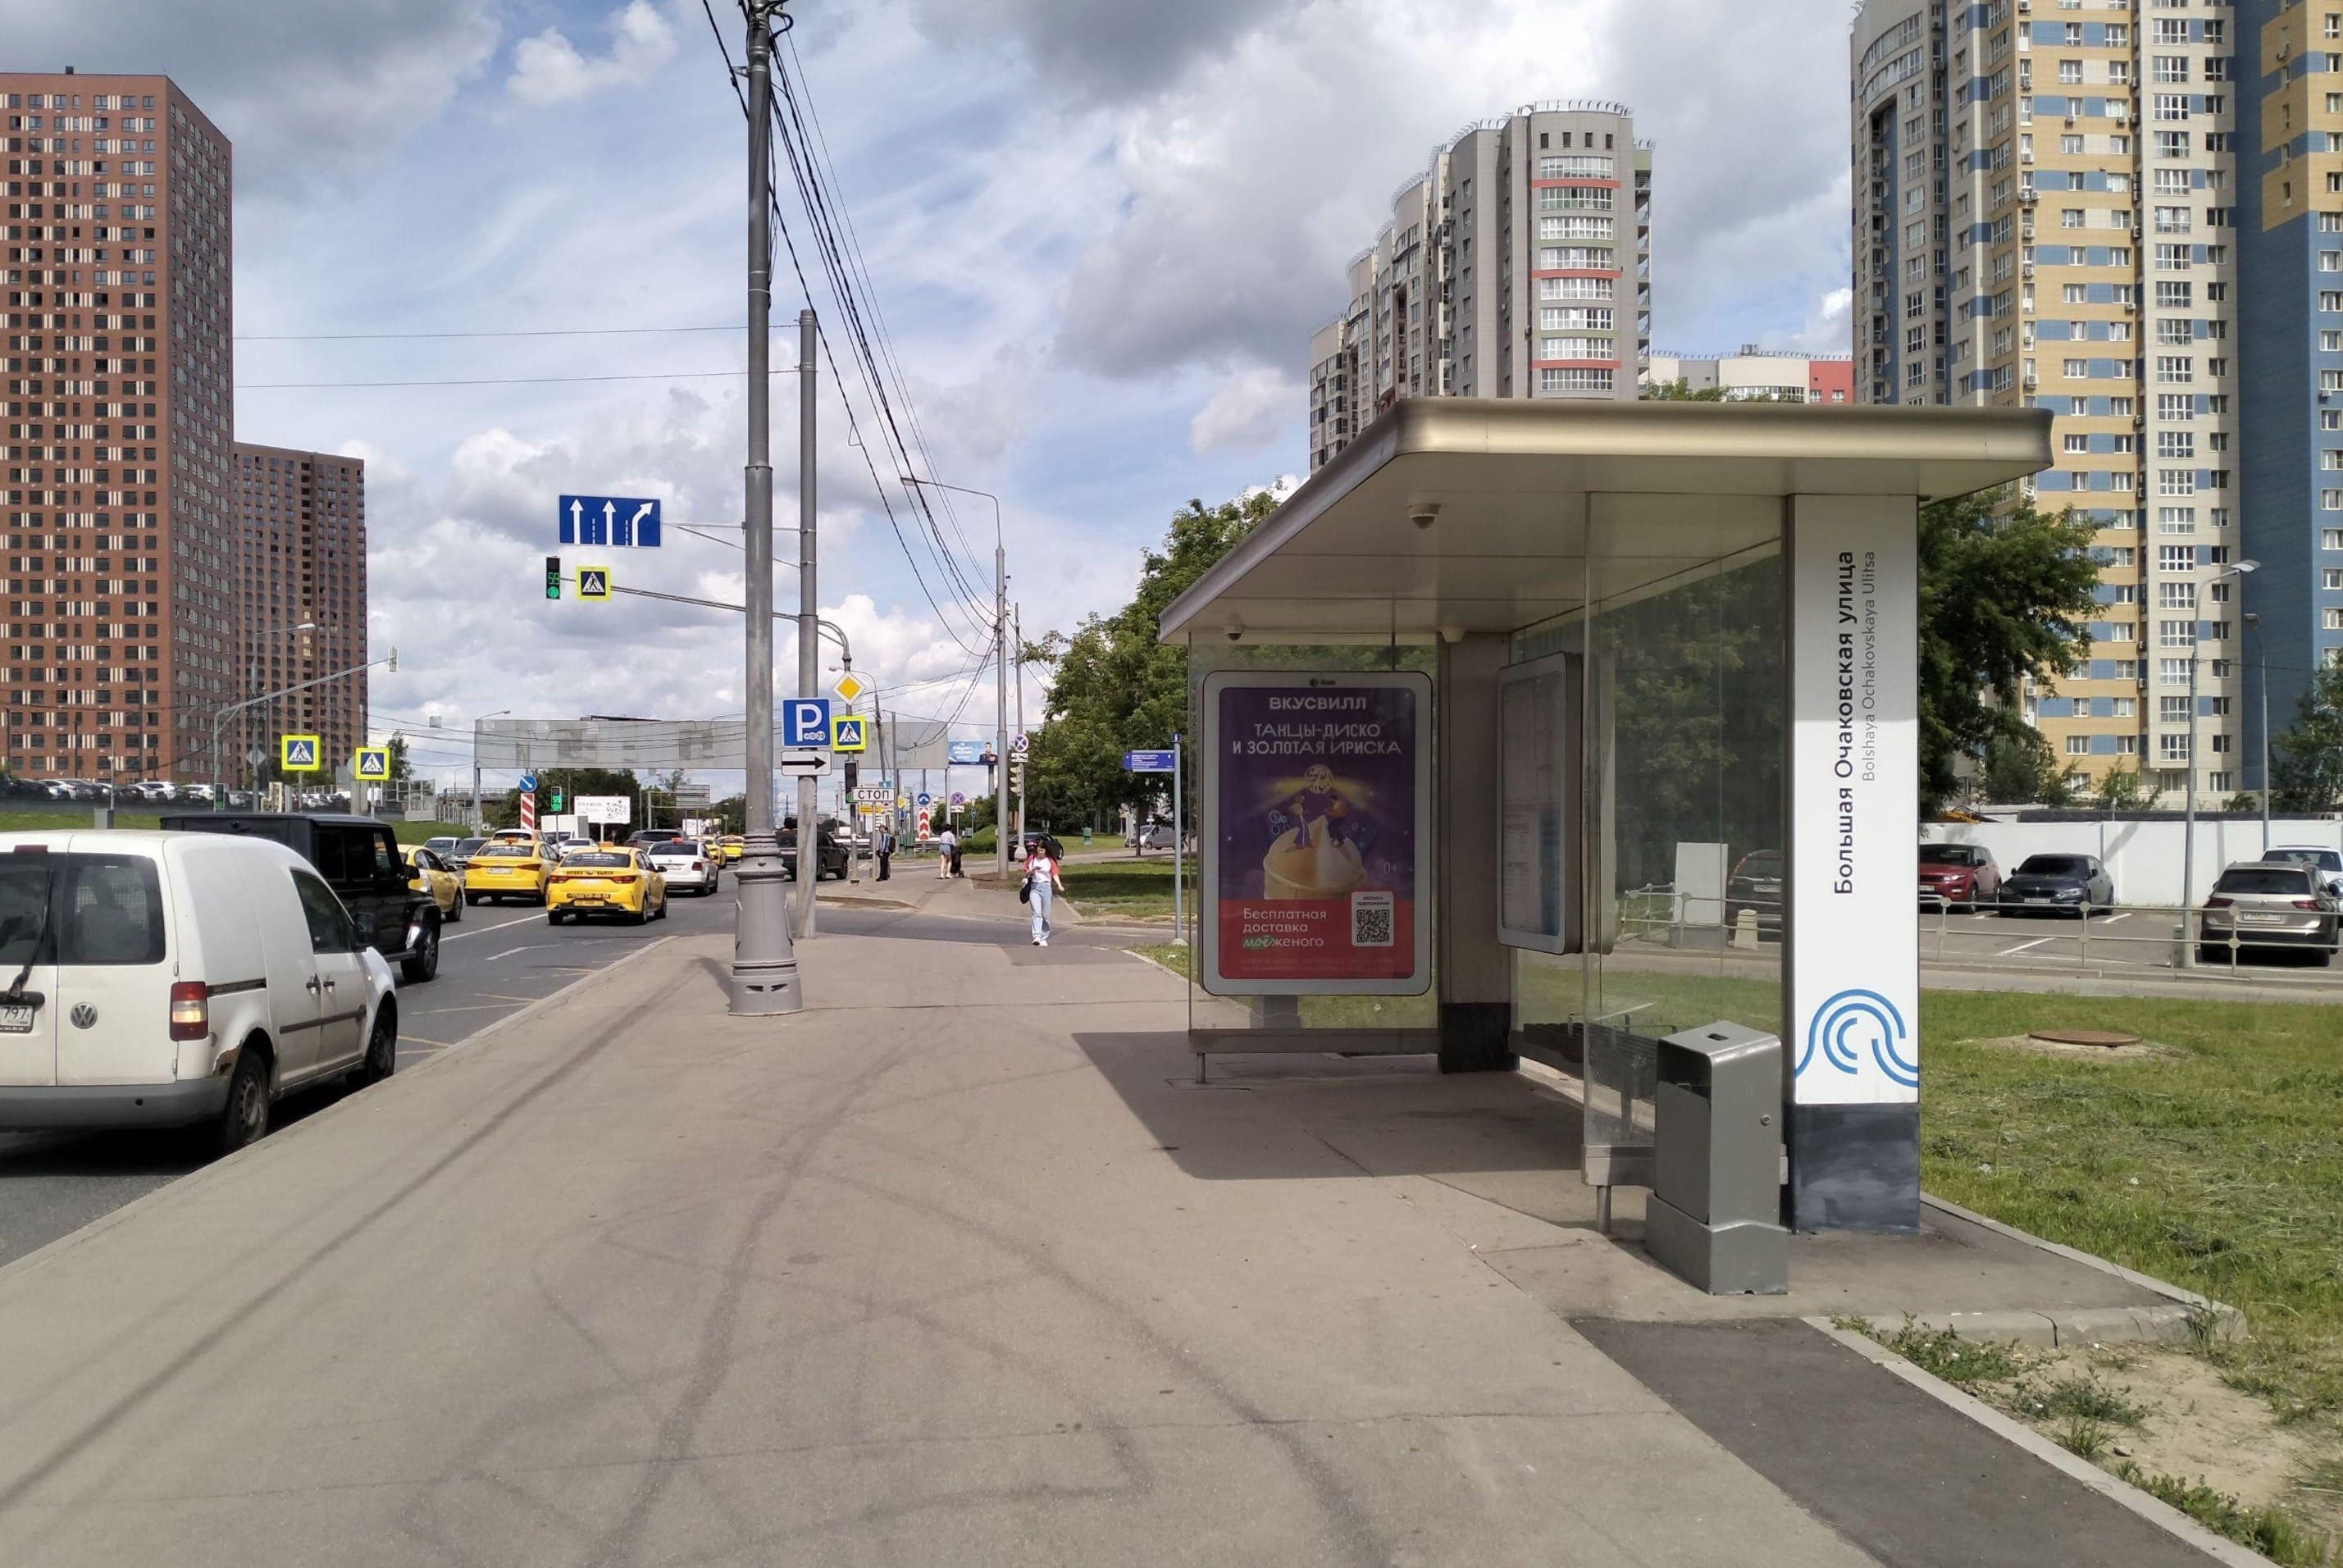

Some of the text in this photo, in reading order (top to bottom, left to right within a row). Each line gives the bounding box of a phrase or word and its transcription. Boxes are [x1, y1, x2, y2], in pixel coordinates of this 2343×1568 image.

[548, 572, 559, 584] 59
[1862, 551, 1877, 781] Bolshaya Ochakovskaya Ulitsa
[1270, 697, 1366, 709] ВКУСВИЛЛ
[795, 704, 823, 741] P
[1835, 551, 1858, 894] Большая Очаковская улица
[1255, 723, 1380, 738] ТАНЦЫ-ДИСКО
[1233, 741, 1401, 754] И ЗОЛОТАЯ ИРИСКА
[858, 790, 889, 800] СТОП
[1383, 861, 1397, 875] 0+
[1243, 908, 1327, 919] Бесплатная
[1243, 923, 1308, 933] доставка
[3, 1006, 28, 1019] 797
